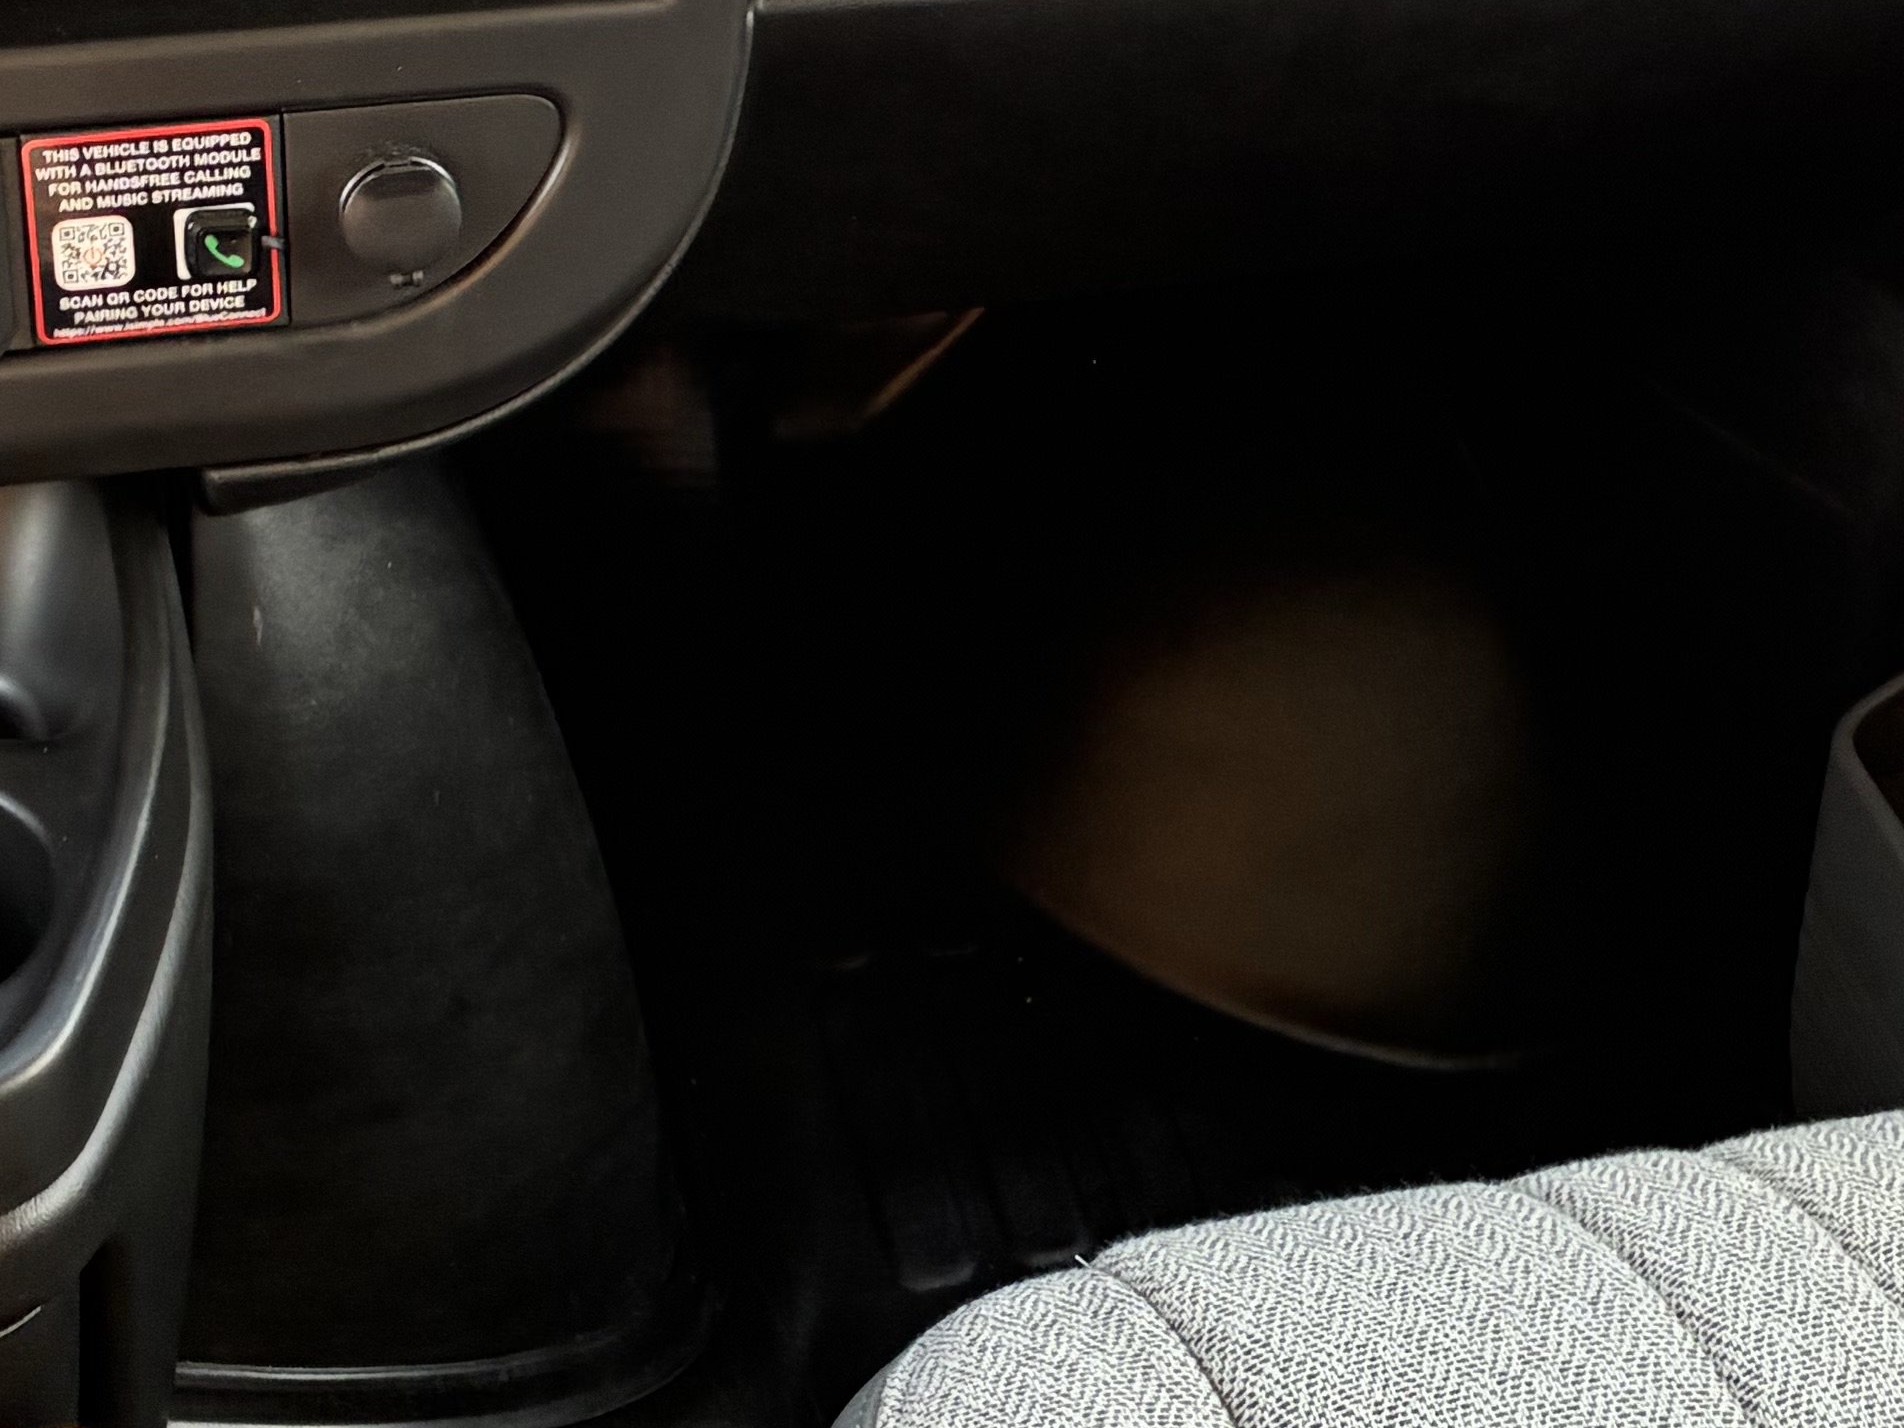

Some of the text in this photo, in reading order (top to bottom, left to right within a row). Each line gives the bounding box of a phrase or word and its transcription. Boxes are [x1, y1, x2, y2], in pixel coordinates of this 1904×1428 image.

[43, 132, 252, 163] THIS VEHICLE IS EQUIPPED
[35, 148, 261, 181] WITH A BLUETOOTH MODULE
[48, 166, 252, 197] FOR HANDSFREE CALLING
[59, 183, 244, 212] AND MUSIC STREAMING
[59, 279, 258, 311] SCAN QR CODE FOR HELP
[74, 295, 245, 325] PAIRING YOUR DEVICE
